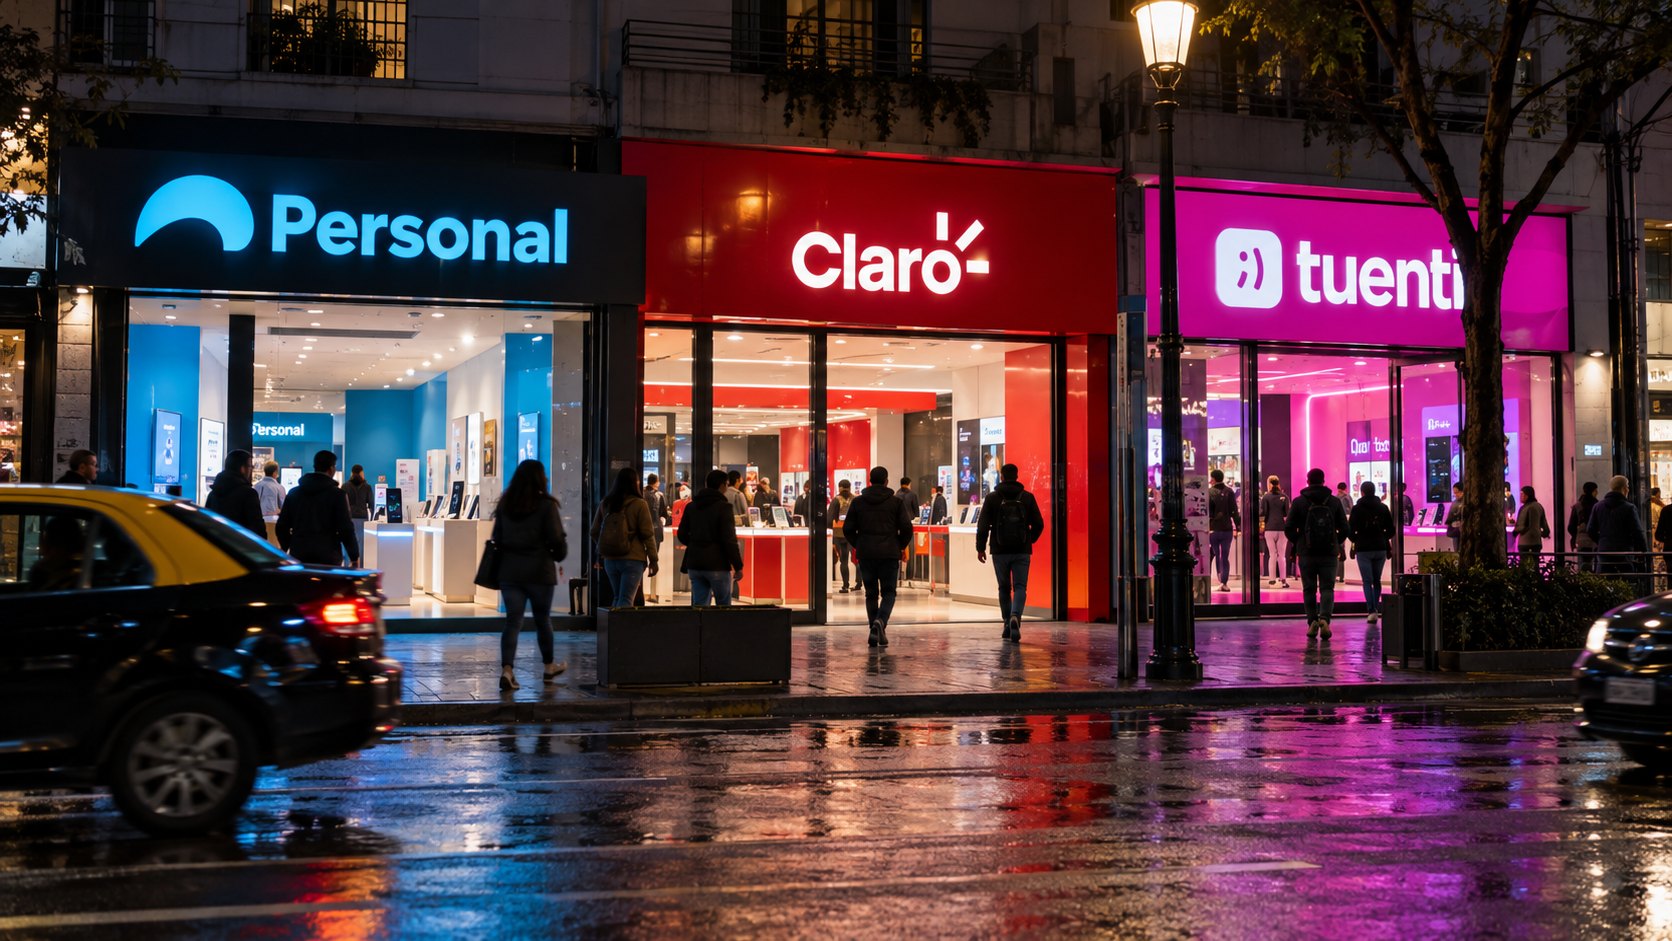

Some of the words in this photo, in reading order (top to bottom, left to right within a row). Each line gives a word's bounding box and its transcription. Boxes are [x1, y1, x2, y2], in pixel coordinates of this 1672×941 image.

[271, 194, 568, 264] Personal
[791, 231, 961, 295] Claro
[1296, 240, 1465, 310] tuenti
